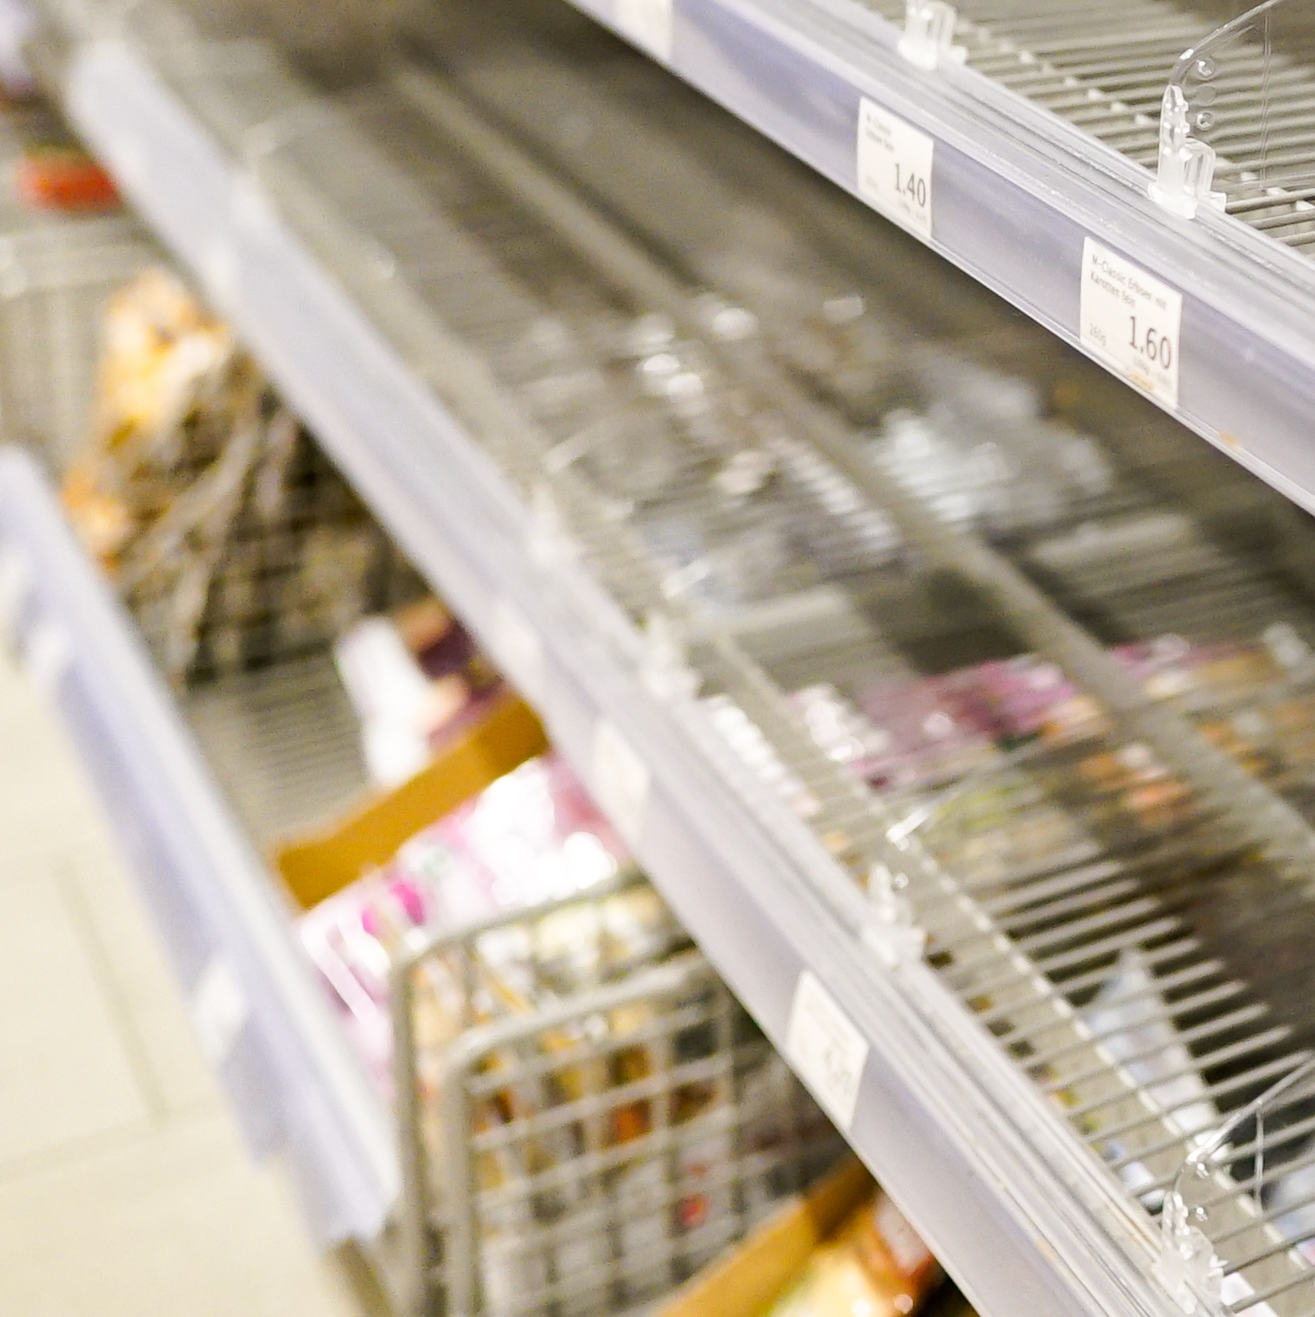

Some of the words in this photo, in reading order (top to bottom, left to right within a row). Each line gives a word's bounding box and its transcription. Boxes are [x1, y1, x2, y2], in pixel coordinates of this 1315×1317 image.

[895, 163, 926, 207] 1.40
[1092, 254, 1126, 285] M-Classic
[1129, 316, 1171, 369] 1.60
